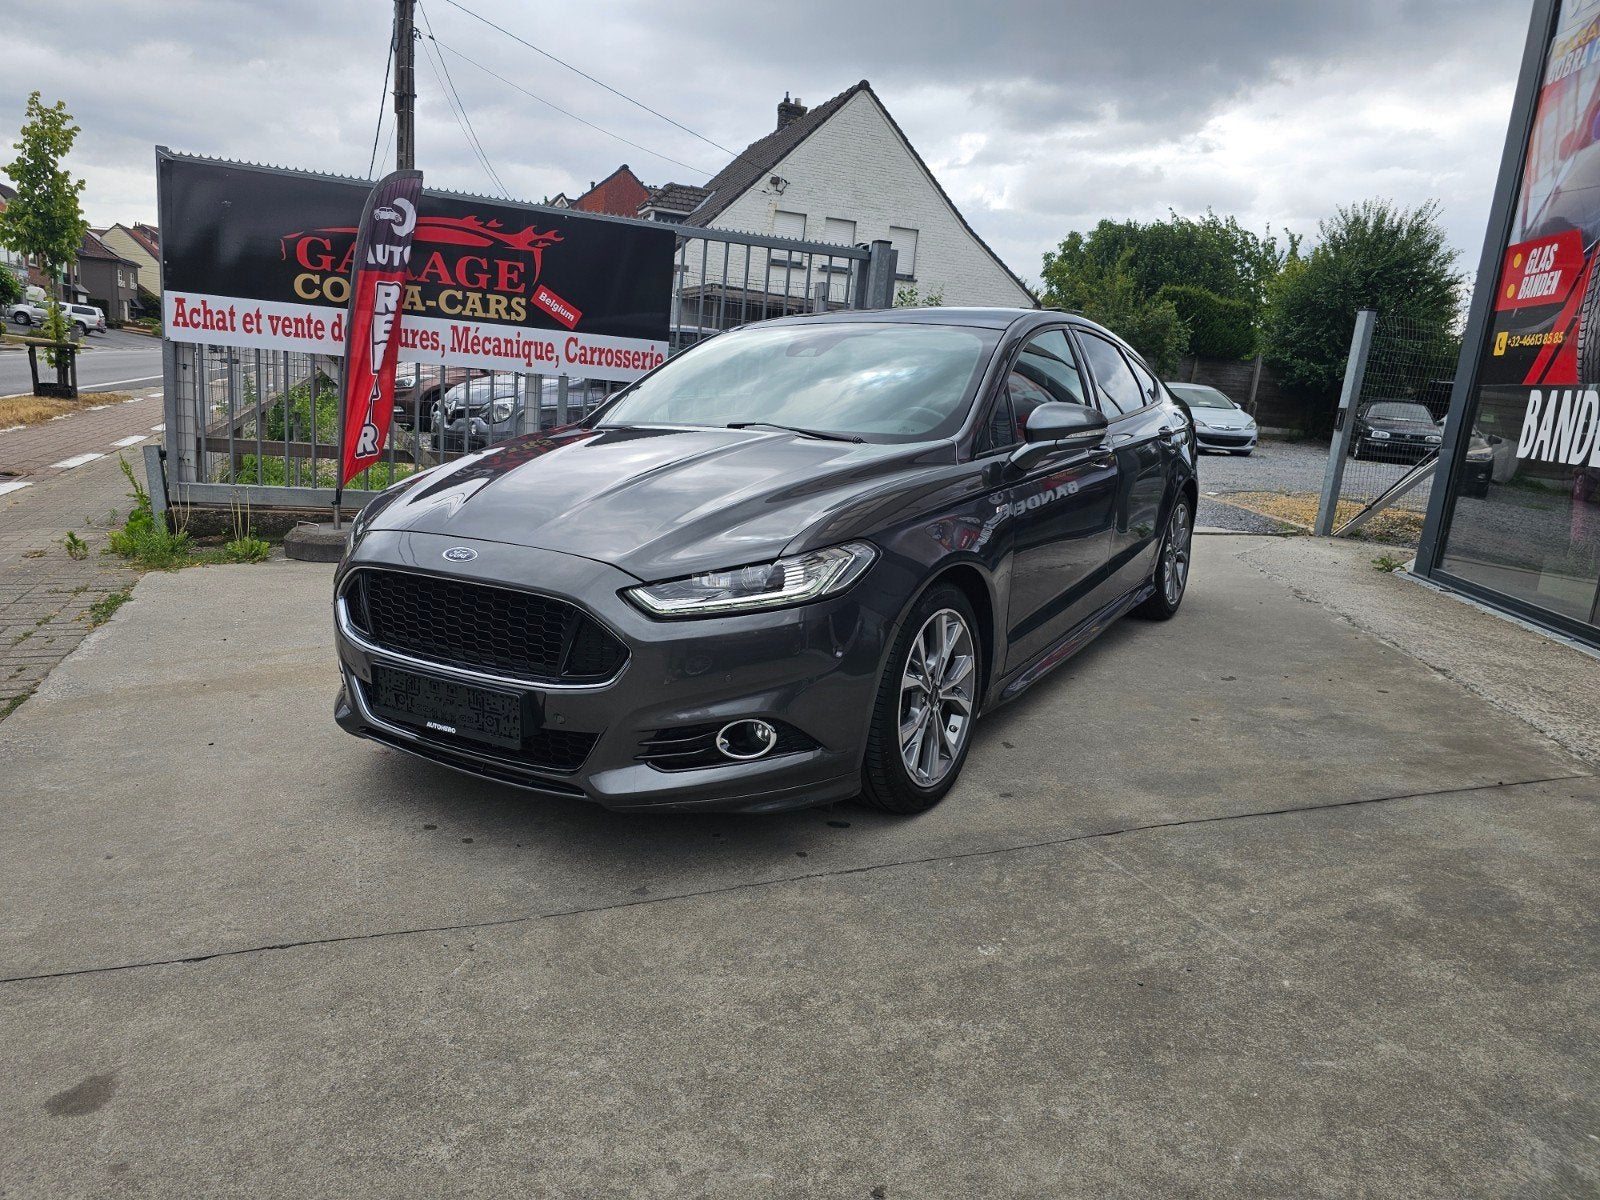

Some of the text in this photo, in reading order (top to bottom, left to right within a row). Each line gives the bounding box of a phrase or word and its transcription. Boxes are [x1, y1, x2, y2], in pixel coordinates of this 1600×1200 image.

[1525, 243, 1558, 275] GLAS
[293, 273, 527, 321] COA-CARS
[1517, 270, 1562, 299] BANDEN
[538, 291, 575, 321] Belgium
[172, 297, 236, 332] Achat
[242, 307, 262, 335] et
[268, 312, 326, 341] vente
[450, 325, 560, 368] Mécanique,
[565, 336, 663, 371] Carrosserie
